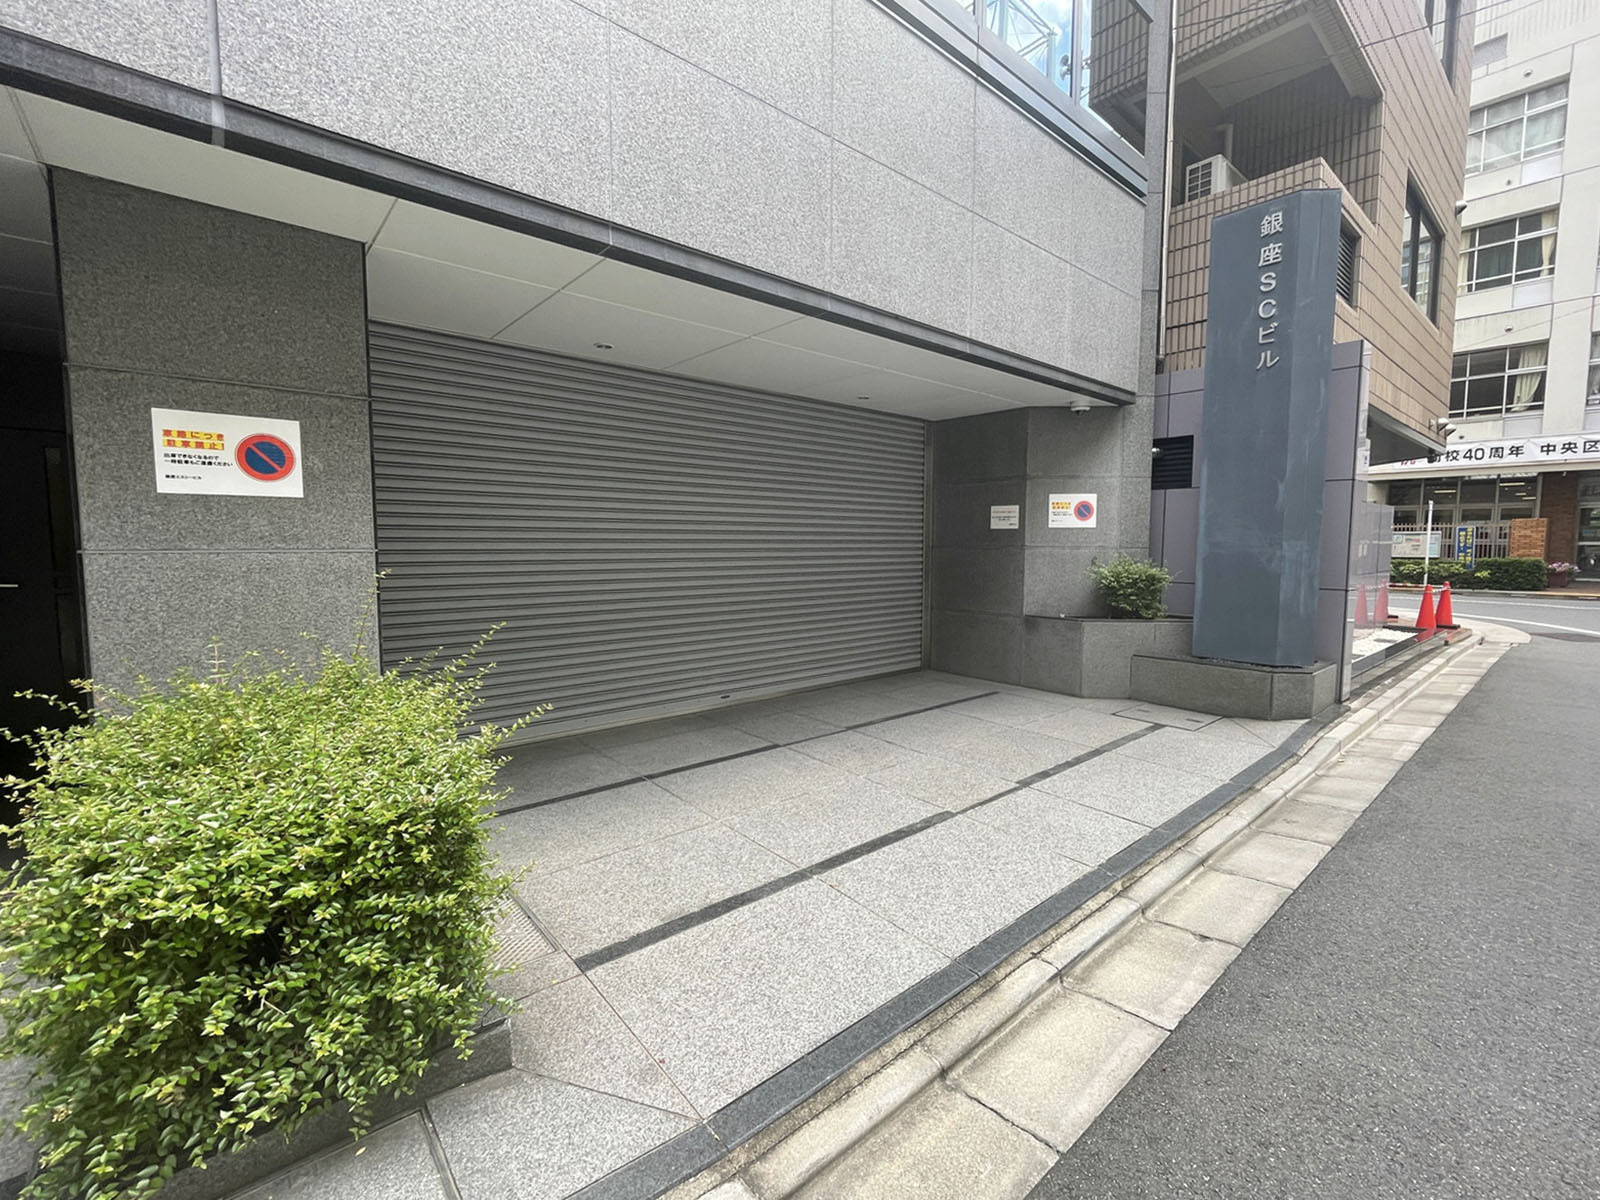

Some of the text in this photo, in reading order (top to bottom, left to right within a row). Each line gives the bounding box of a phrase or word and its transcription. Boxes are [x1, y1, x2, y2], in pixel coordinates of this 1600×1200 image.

[1256, 211, 1283, 371] 銀座SCビル
[1540, 440, 1600, 456] 中央区
